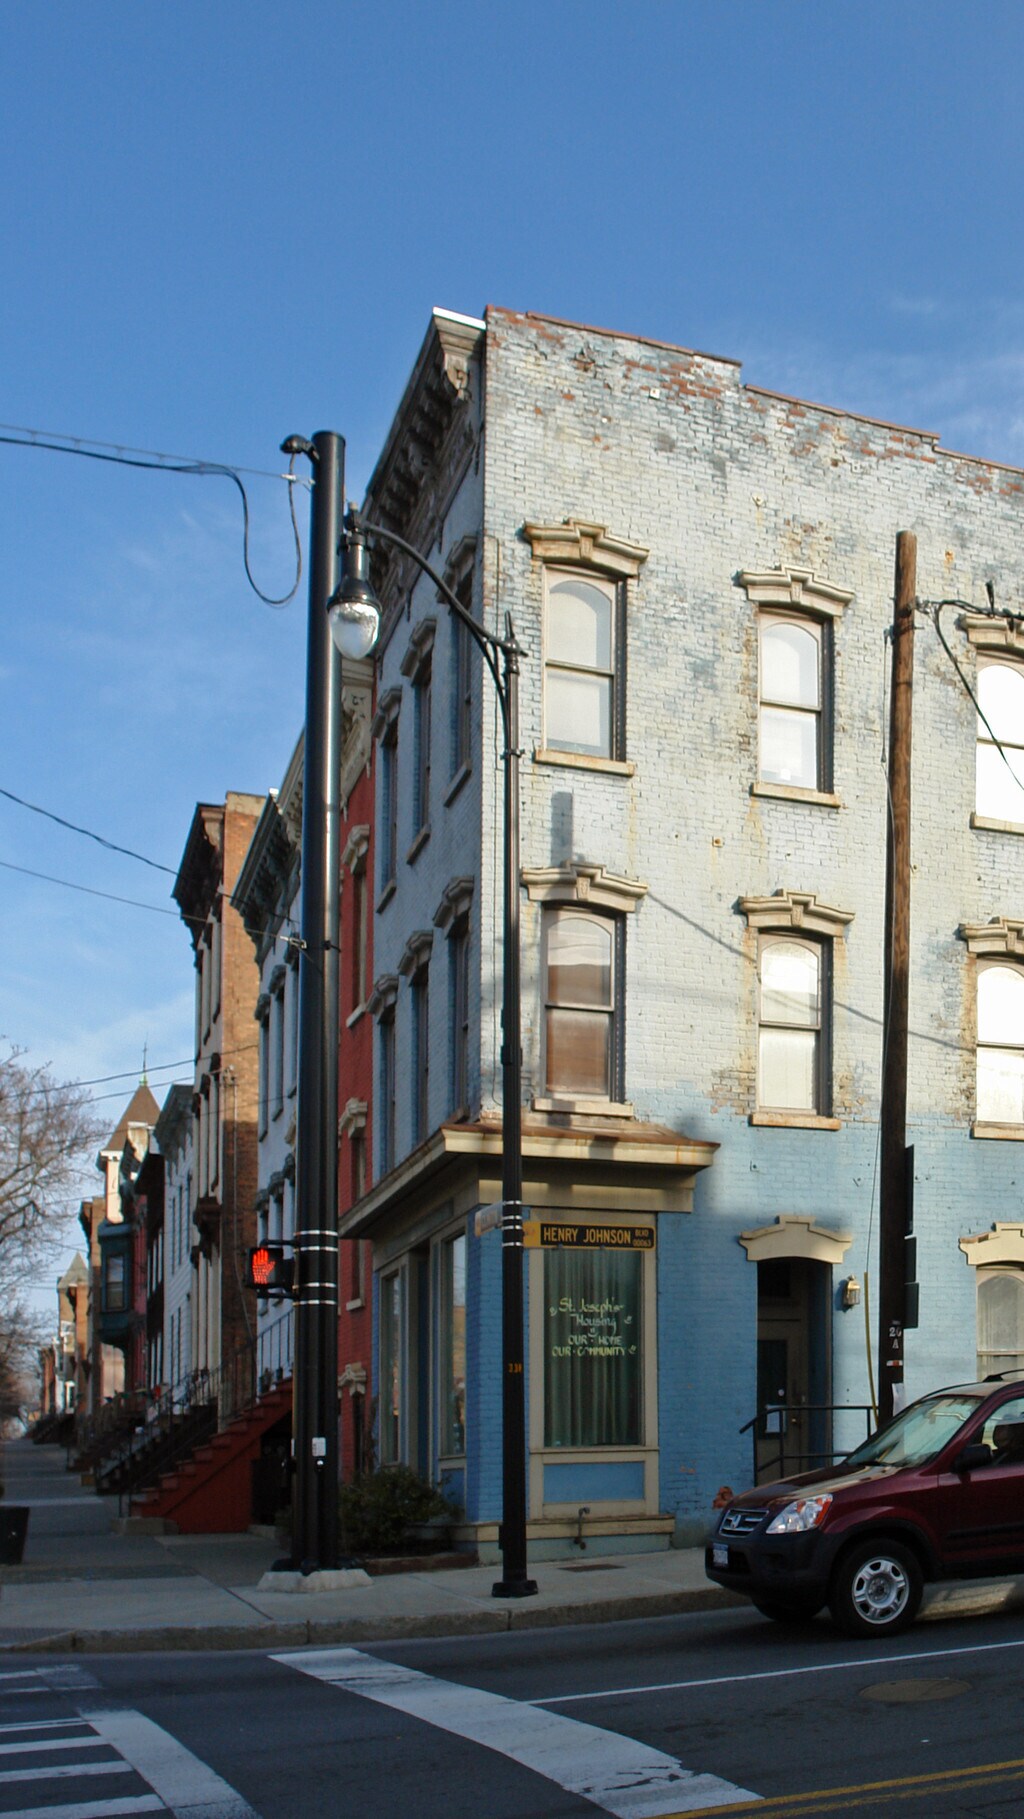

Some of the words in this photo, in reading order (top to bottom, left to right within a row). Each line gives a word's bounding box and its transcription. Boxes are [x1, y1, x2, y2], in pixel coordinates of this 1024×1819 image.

[543, 1227, 579, 1242] HENRY
[583, 1229, 631, 1244] JOHNSON
[570, 1313, 617, 1335] Housing
[568, 1335, 588, 1345] OUR
[598, 1335, 623, 1345] HOME
[551, 1346, 571, 1357] OUR
